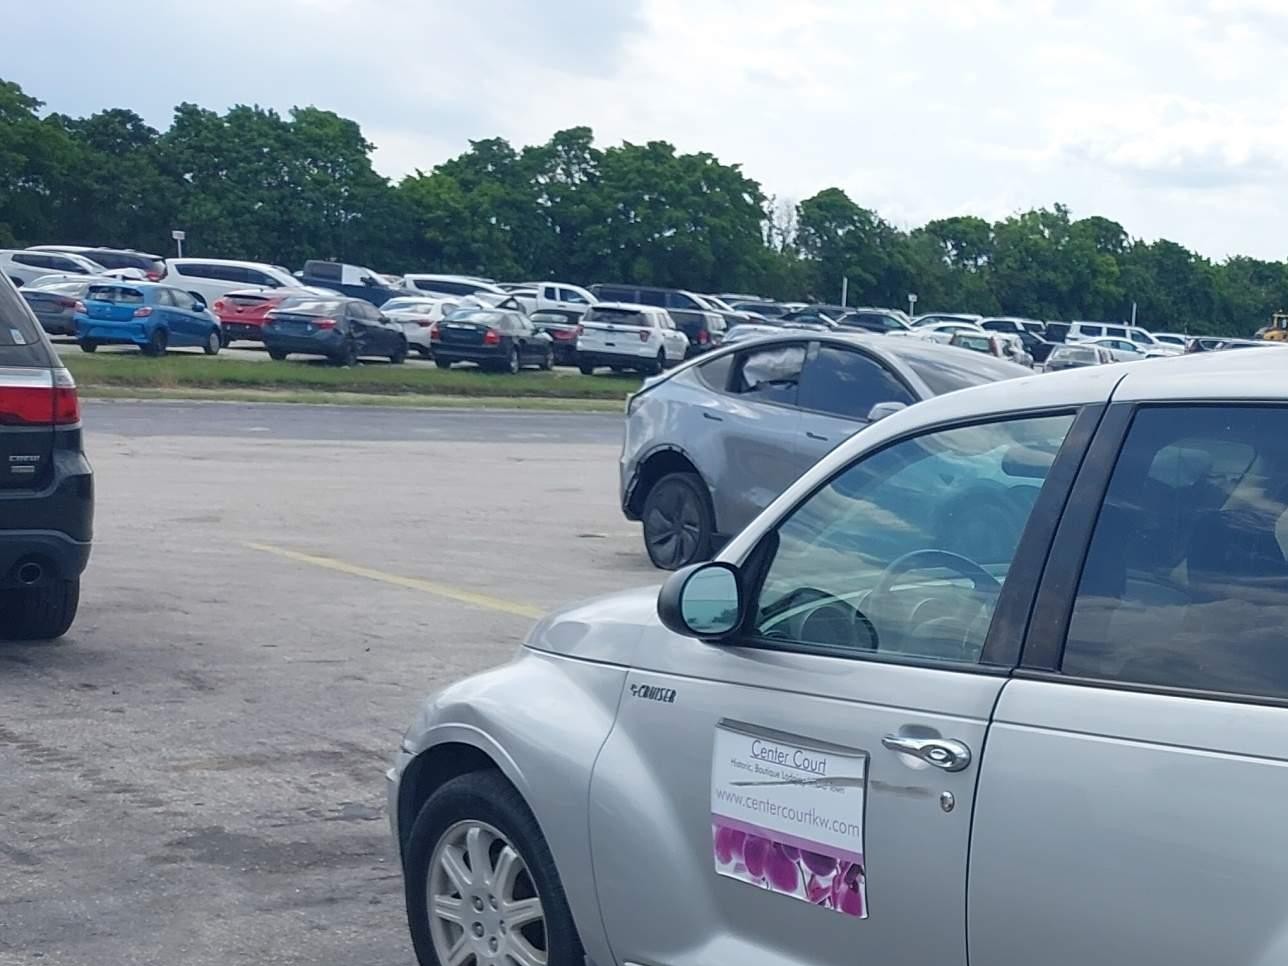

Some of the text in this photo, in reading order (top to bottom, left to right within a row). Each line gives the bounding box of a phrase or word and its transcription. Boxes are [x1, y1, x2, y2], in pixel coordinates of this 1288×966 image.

[638, 685, 677, 703] CRUISER
[751, 739, 827, 773] Center Court
[716, 788, 861, 837] www.centercourtkw.com
